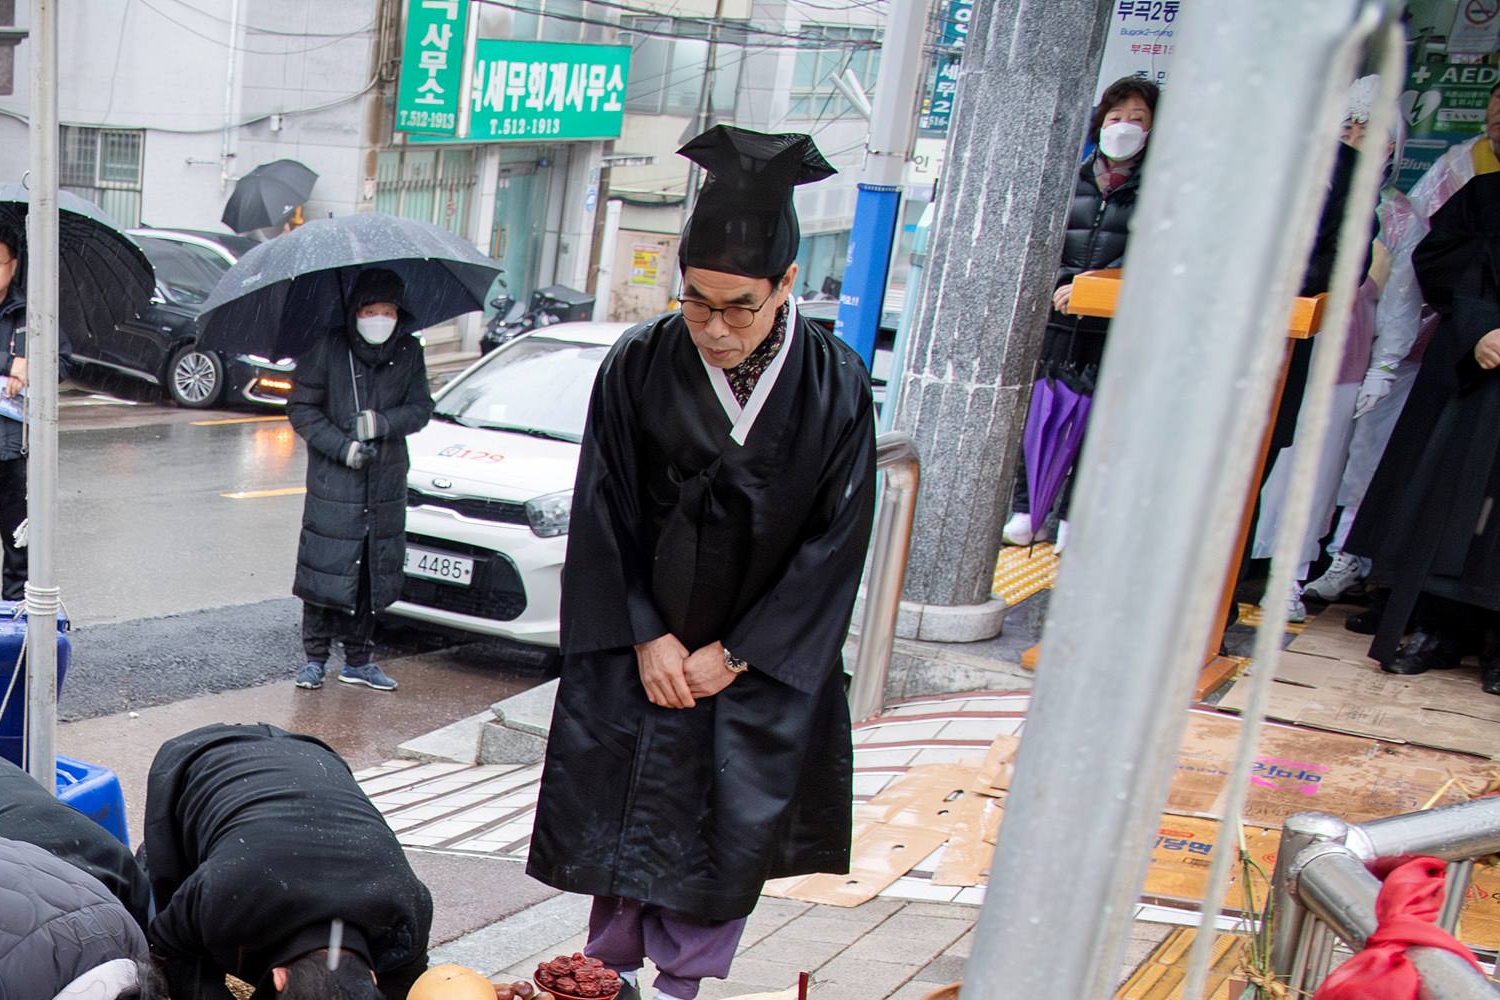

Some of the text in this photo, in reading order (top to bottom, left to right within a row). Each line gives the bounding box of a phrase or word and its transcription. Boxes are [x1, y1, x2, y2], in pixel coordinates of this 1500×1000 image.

[1117, 1, 1180, 23] 부곡2동
[1439, 66, 1498, 84] AED
[400, 110, 456, 129] T.512-1913
[489, 118, 561, 135] T.512-1913
[418, 554, 463, 579] 4485
[1155, 836, 1213, 855] 당면
